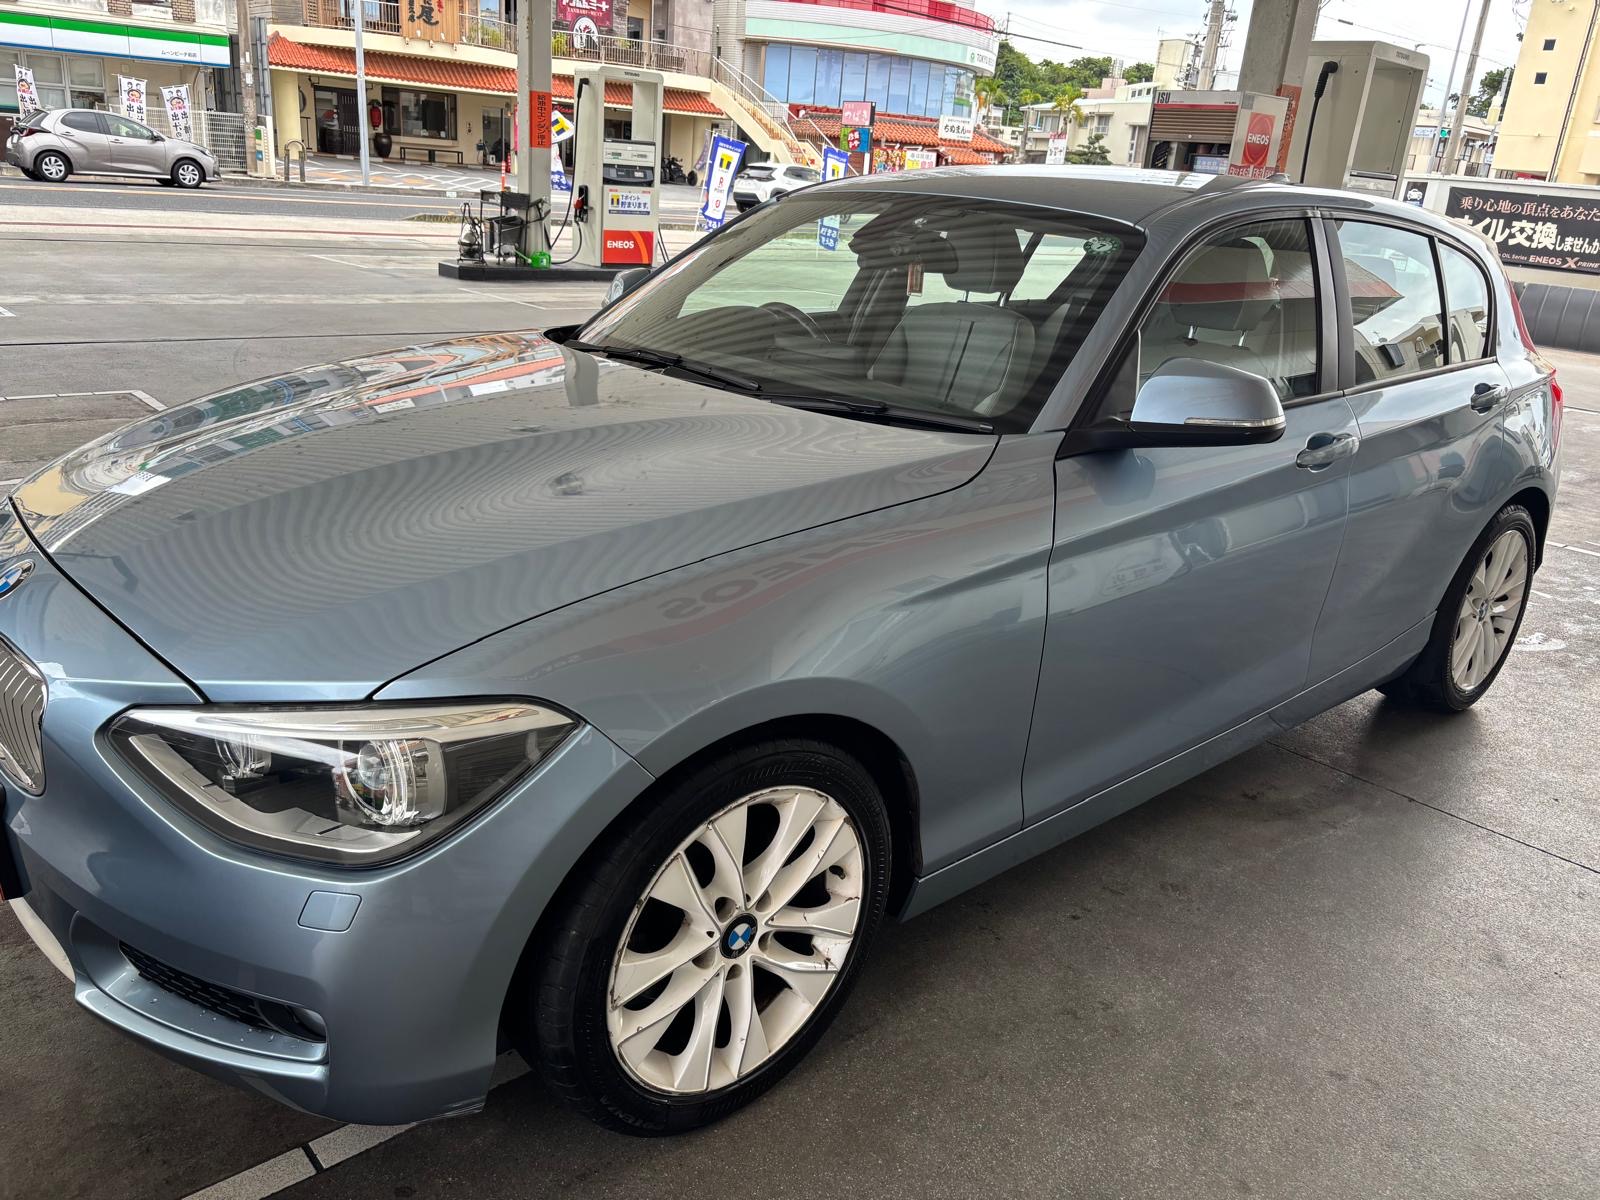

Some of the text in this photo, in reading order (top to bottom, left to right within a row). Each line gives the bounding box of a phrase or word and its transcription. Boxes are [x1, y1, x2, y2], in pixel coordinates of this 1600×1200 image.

[1247, 133, 1270, 145] ENEOS
[606, 240, 635, 249] ENEOS
[1528, 255, 1562, 265] ENEOS
